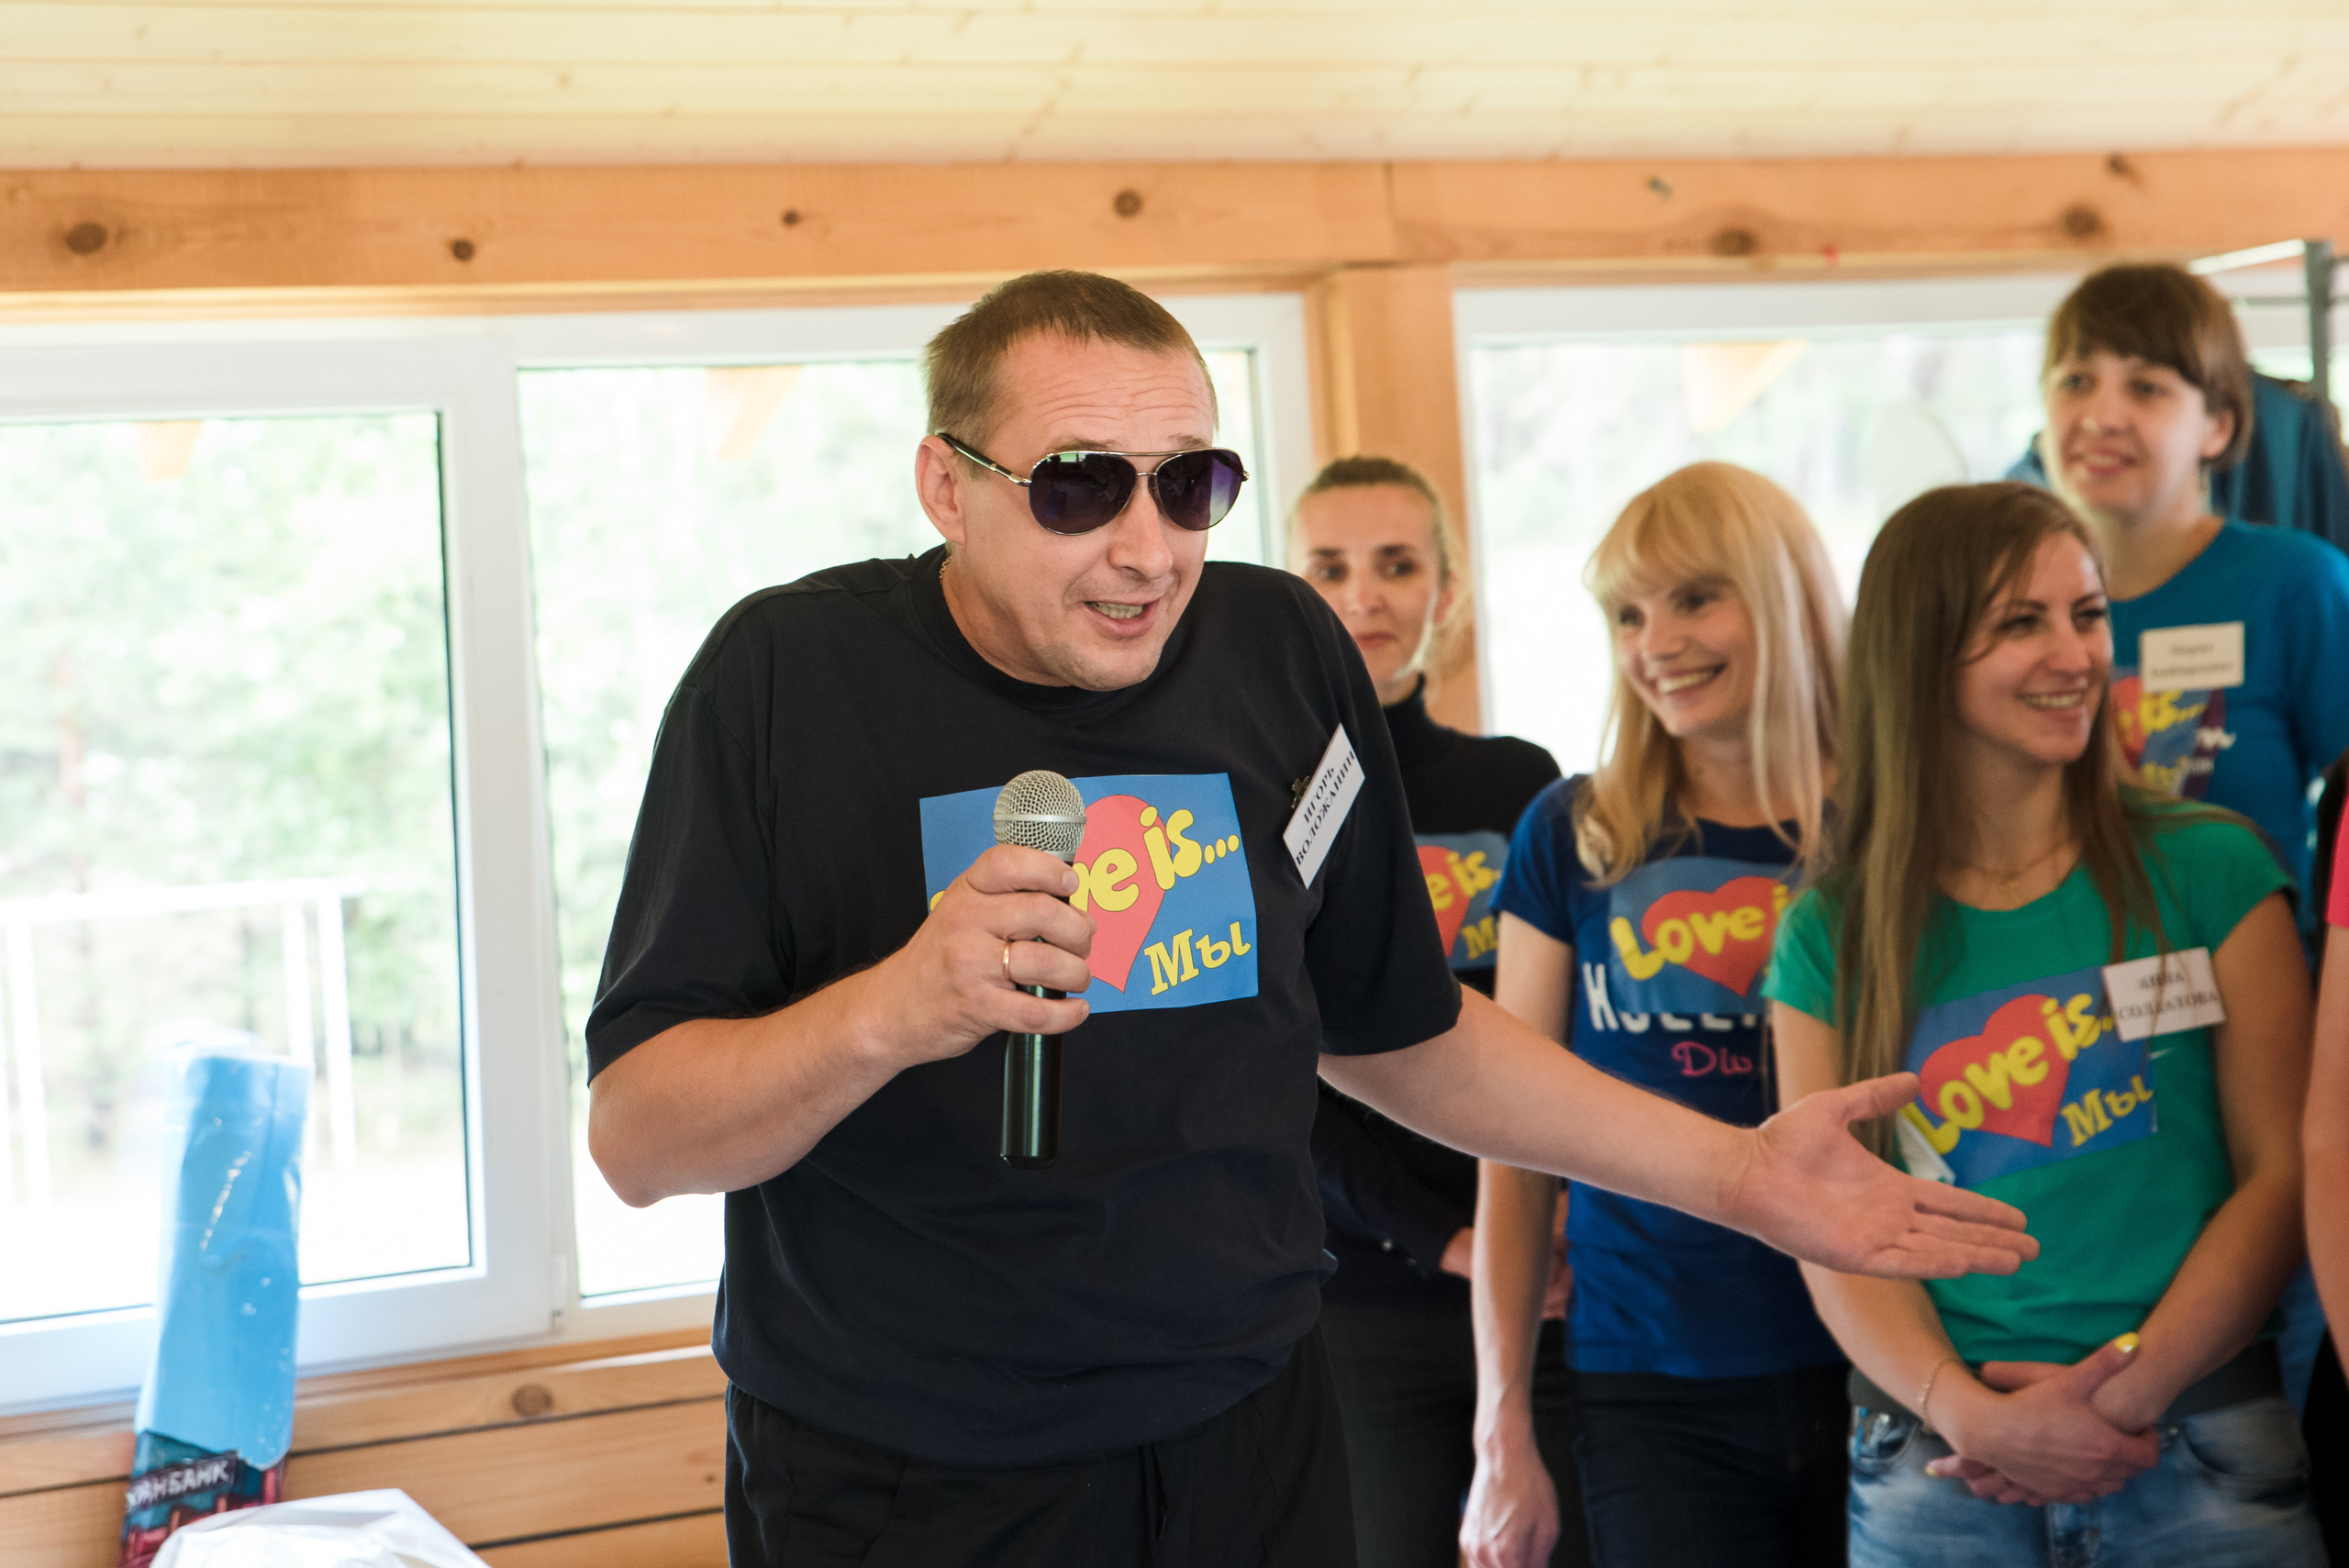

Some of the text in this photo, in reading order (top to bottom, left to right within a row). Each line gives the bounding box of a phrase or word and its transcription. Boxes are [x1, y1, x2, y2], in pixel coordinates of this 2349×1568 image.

[1296, 751, 1354, 866] ВОЛОЖАНИН
[1303, 767, 1334, 823] ИГОРЬ
[1140, 806, 1240, 890] is...
[1144, 921, 1253, 996] Мы
[1609, 905, 1765, 981] Love
[1899, 1035, 2049, 1155] Love
[2061, 1075, 2153, 1147] Мы
